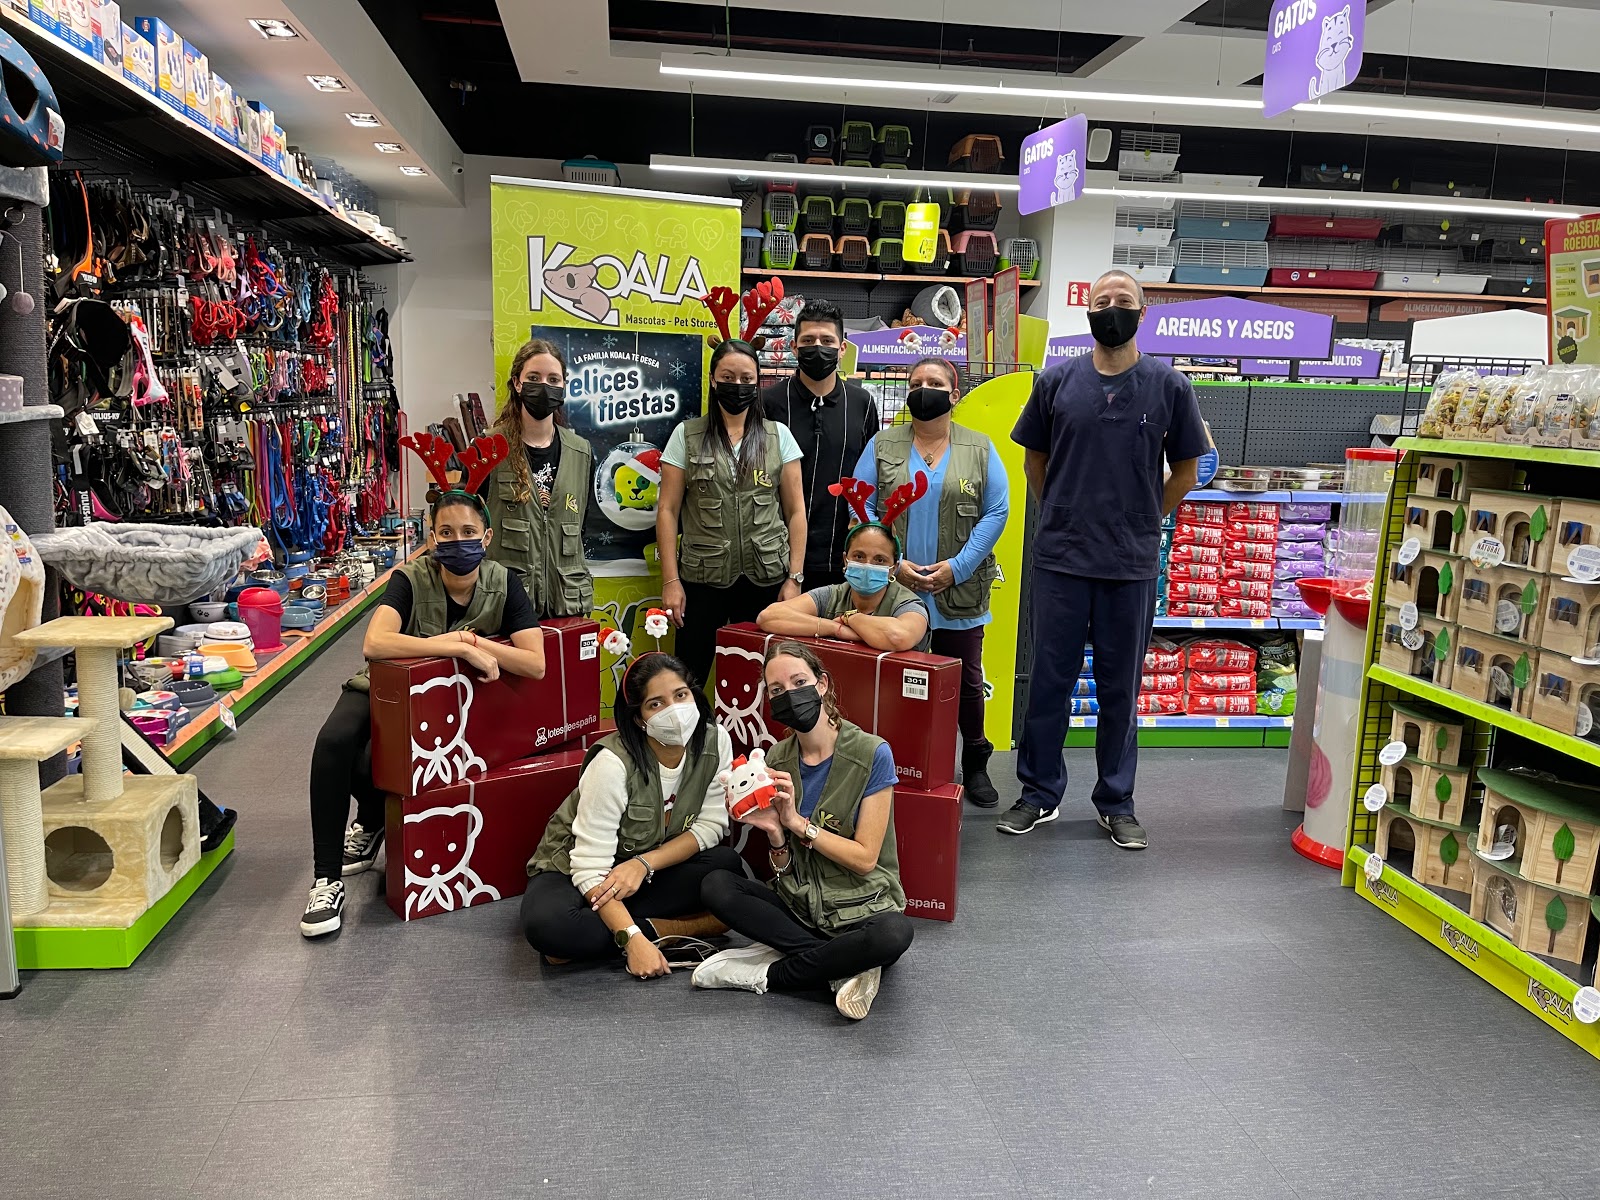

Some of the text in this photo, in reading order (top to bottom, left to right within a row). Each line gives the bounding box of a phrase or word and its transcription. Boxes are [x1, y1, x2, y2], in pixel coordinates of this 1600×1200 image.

[1274, 0, 1317, 39] GATOS
[1024, 137, 1054, 166] GATOS
[527, 234, 709, 327] KOALA
[1403, 303, 1455, 314] ALIMENTACIÓN
[625, 313, 666, 326] Mascotas
[674, 316, 689, 327] Pet
[691, 317, 718, 329] Stores
[1156, 317, 1295, 340] ARENAS Y ASEOS
[917, 343, 941, 355] SÚPER
[1046, 345, 1095, 357] ALIMENTA
[573, 351, 660, 369] LA FAMILIA KOALA TE DESEA
[598, 392, 676, 423] fiestas
[907, 677, 923, 685] 301
[1526, 978, 1573, 1021] KOALA
